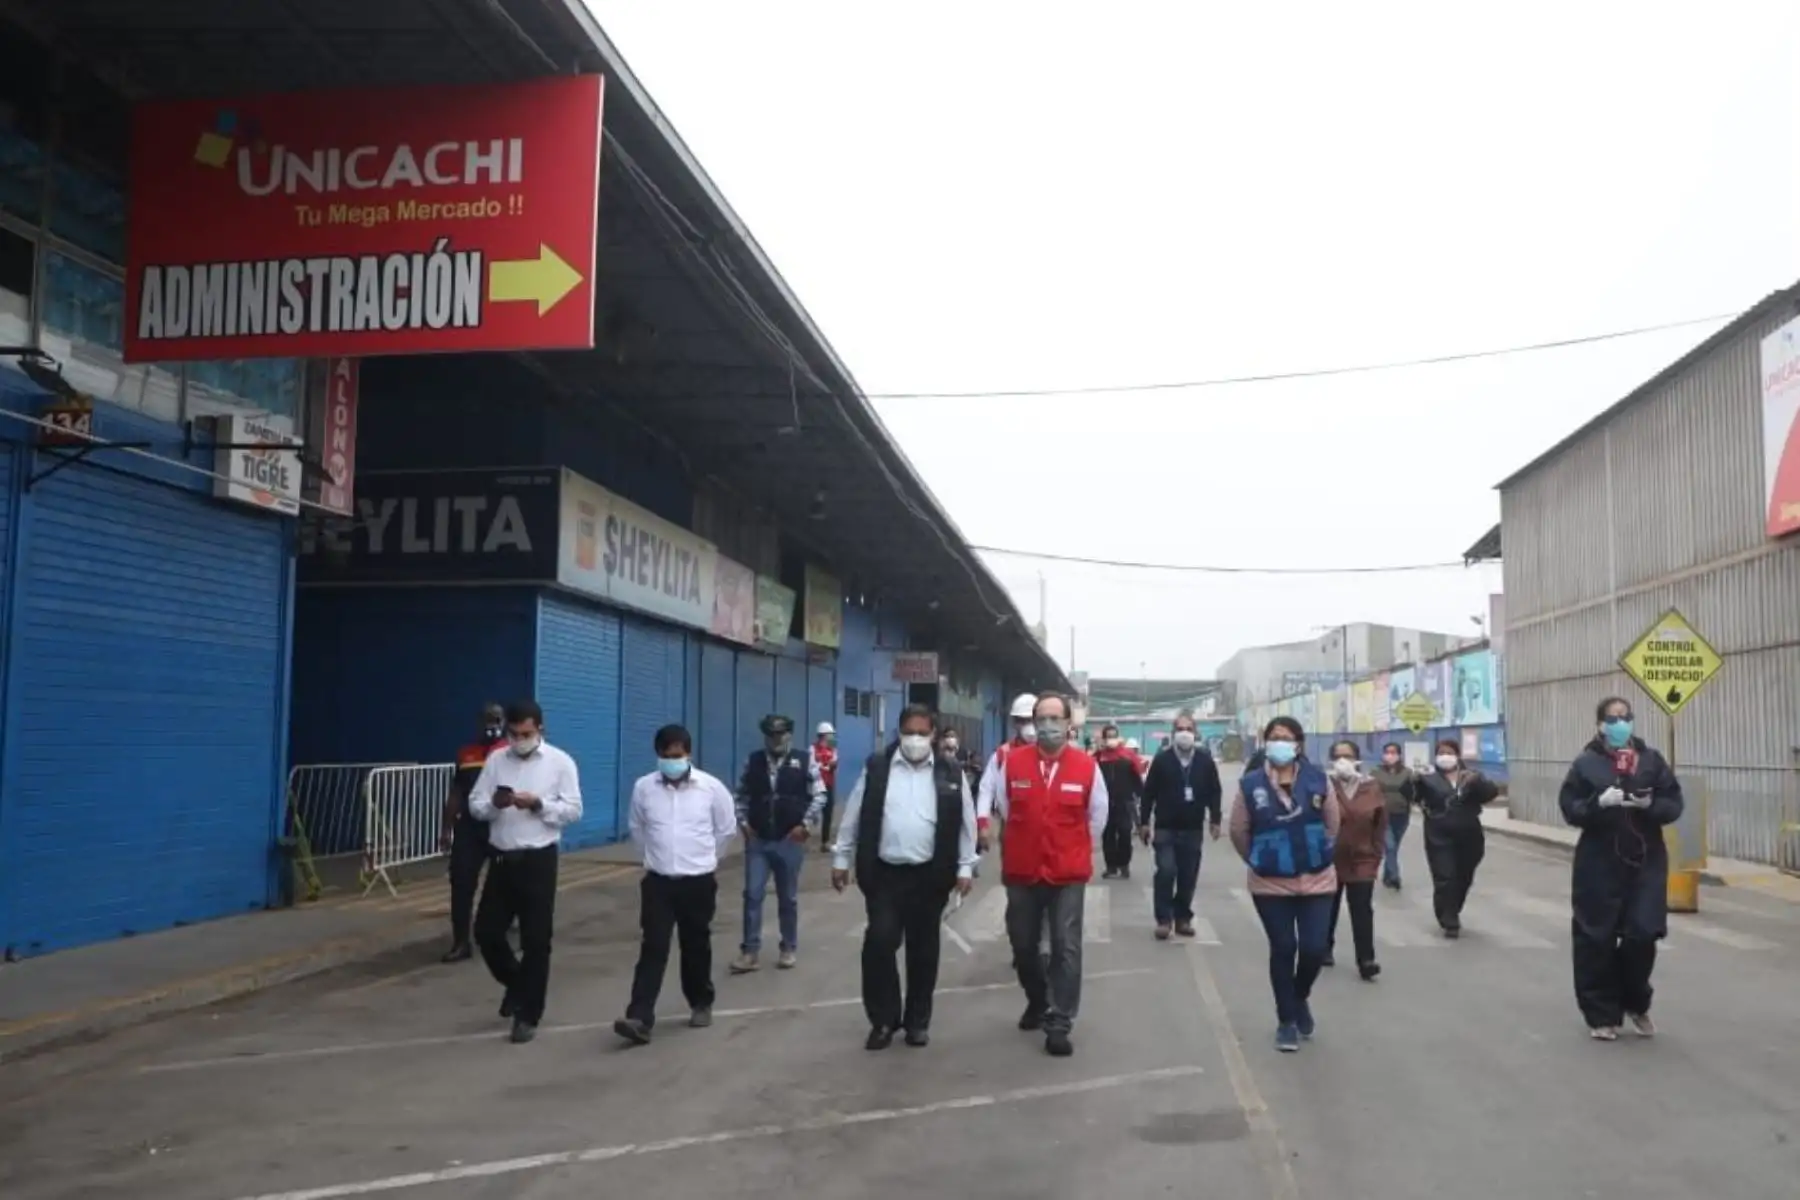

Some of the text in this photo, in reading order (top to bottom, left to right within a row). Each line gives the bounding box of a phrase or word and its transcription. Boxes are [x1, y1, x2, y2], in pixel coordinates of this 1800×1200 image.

[237, 138, 524, 196] UNICACHI
[295, 205, 321, 225] Tu
[328, 202, 390, 228] Mega
[398, 199, 501, 220] Mercado
[138, 238, 483, 340] ADMINISTRACIÓN
[241, 454, 290, 490] TIGRE
[603, 513, 702, 605] SHEYLITA
[1642, 655, 1704, 667] VEHICULAR
[1646, 640, 1696, 652] CONTROL
